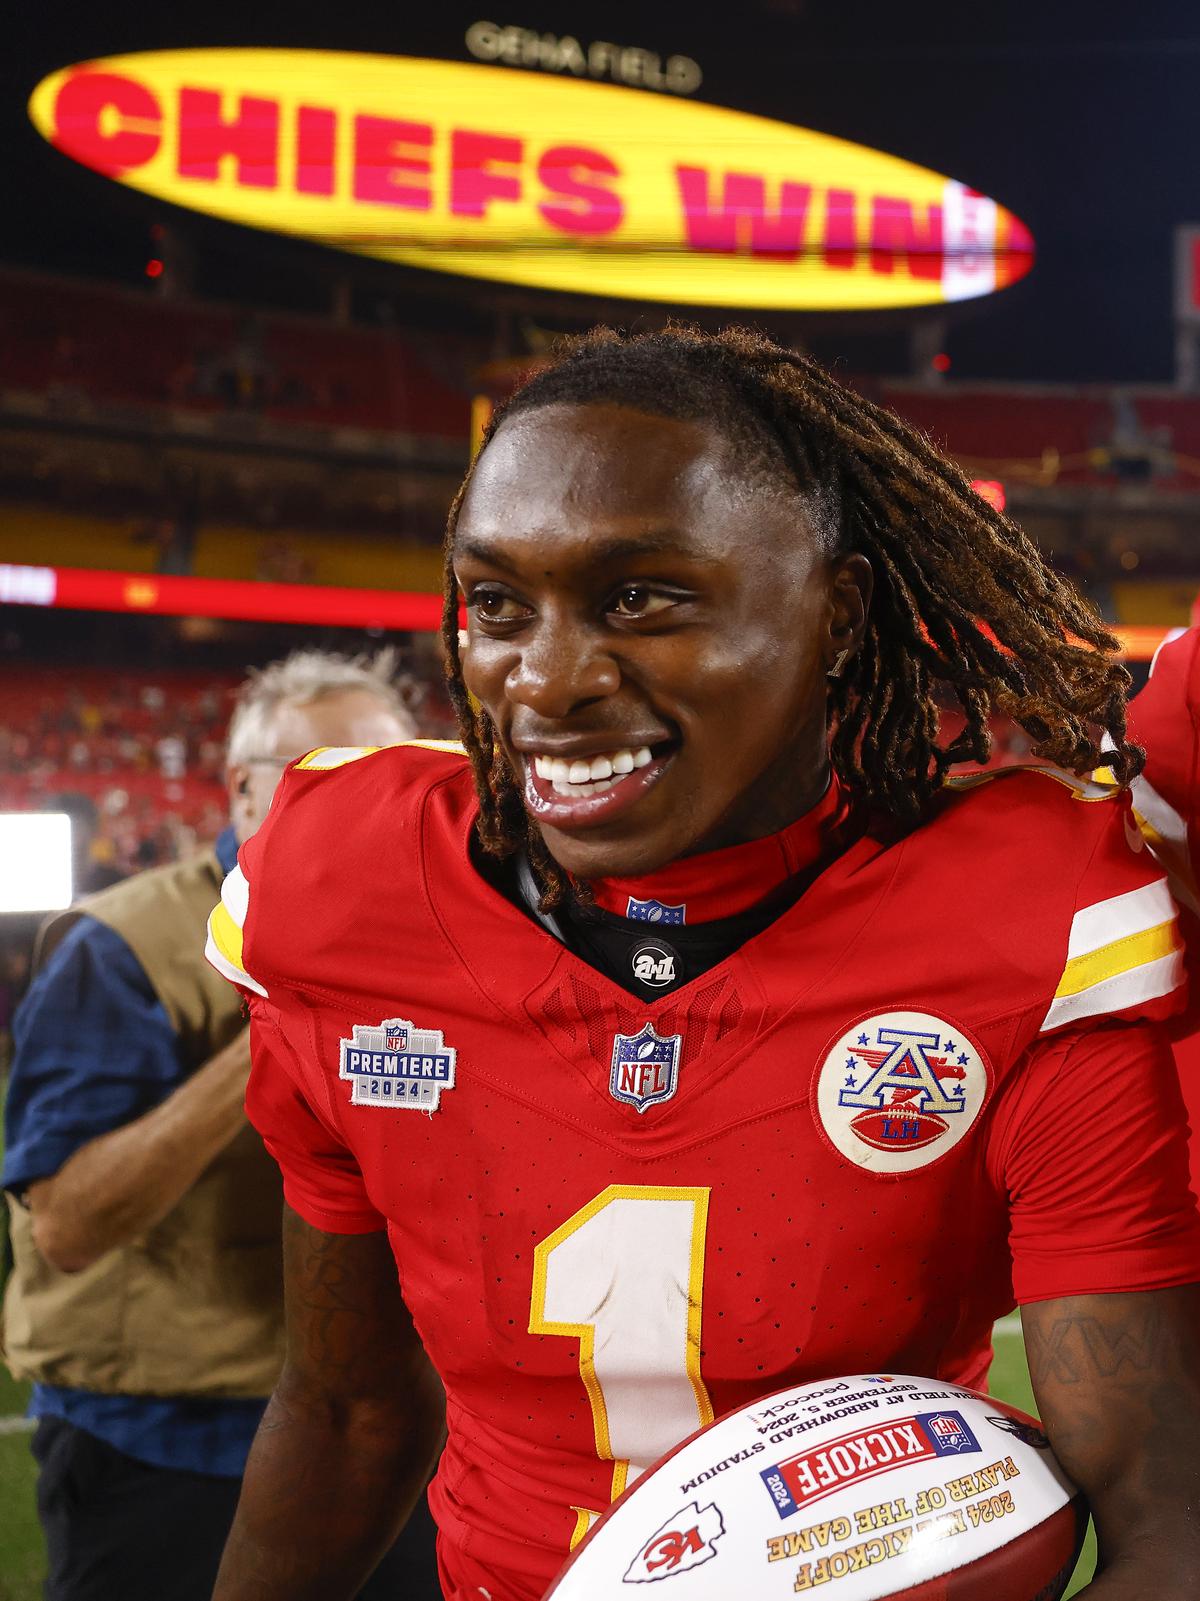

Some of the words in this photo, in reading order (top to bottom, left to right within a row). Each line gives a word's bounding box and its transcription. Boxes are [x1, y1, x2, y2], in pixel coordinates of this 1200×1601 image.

[588, 40, 703, 95] FIELD
[52, 72, 625, 237] CHIEFS
[387, 1036, 406, 1050] NFL
[370, 1080, 419, 1097] 2024
[619, 1063, 667, 1098] NFL
[881, 1119, 921, 1140] LH
[527, 1183, 714, 1553] 1
[757, 1382, 850, 1419] peacock
[801, 1404, 821, 1414] 5,
[824, 1384, 919, 1408] SEPTEMBER
[886, 1394, 905, 1406] AT
[909, 1391, 950, 1401] FIELD
[757, 1412, 800, 1435] 2024
[769, 1399, 880, 1444] ARROWHEAD
[932, 1418, 960, 1435] NFL
[679, 1441, 766, 1494] STADIUM
[797, 1424, 925, 1496] KICKOFF
[766, 1474, 791, 1509] 2024
[944, 1456, 1020, 1502] PLAYER
[854, 1497, 914, 1533] THE
[916, 1486, 946, 1516] OF
[965, 1490, 1015, 1528] 2024
[767, 1516, 852, 1563] GAME
